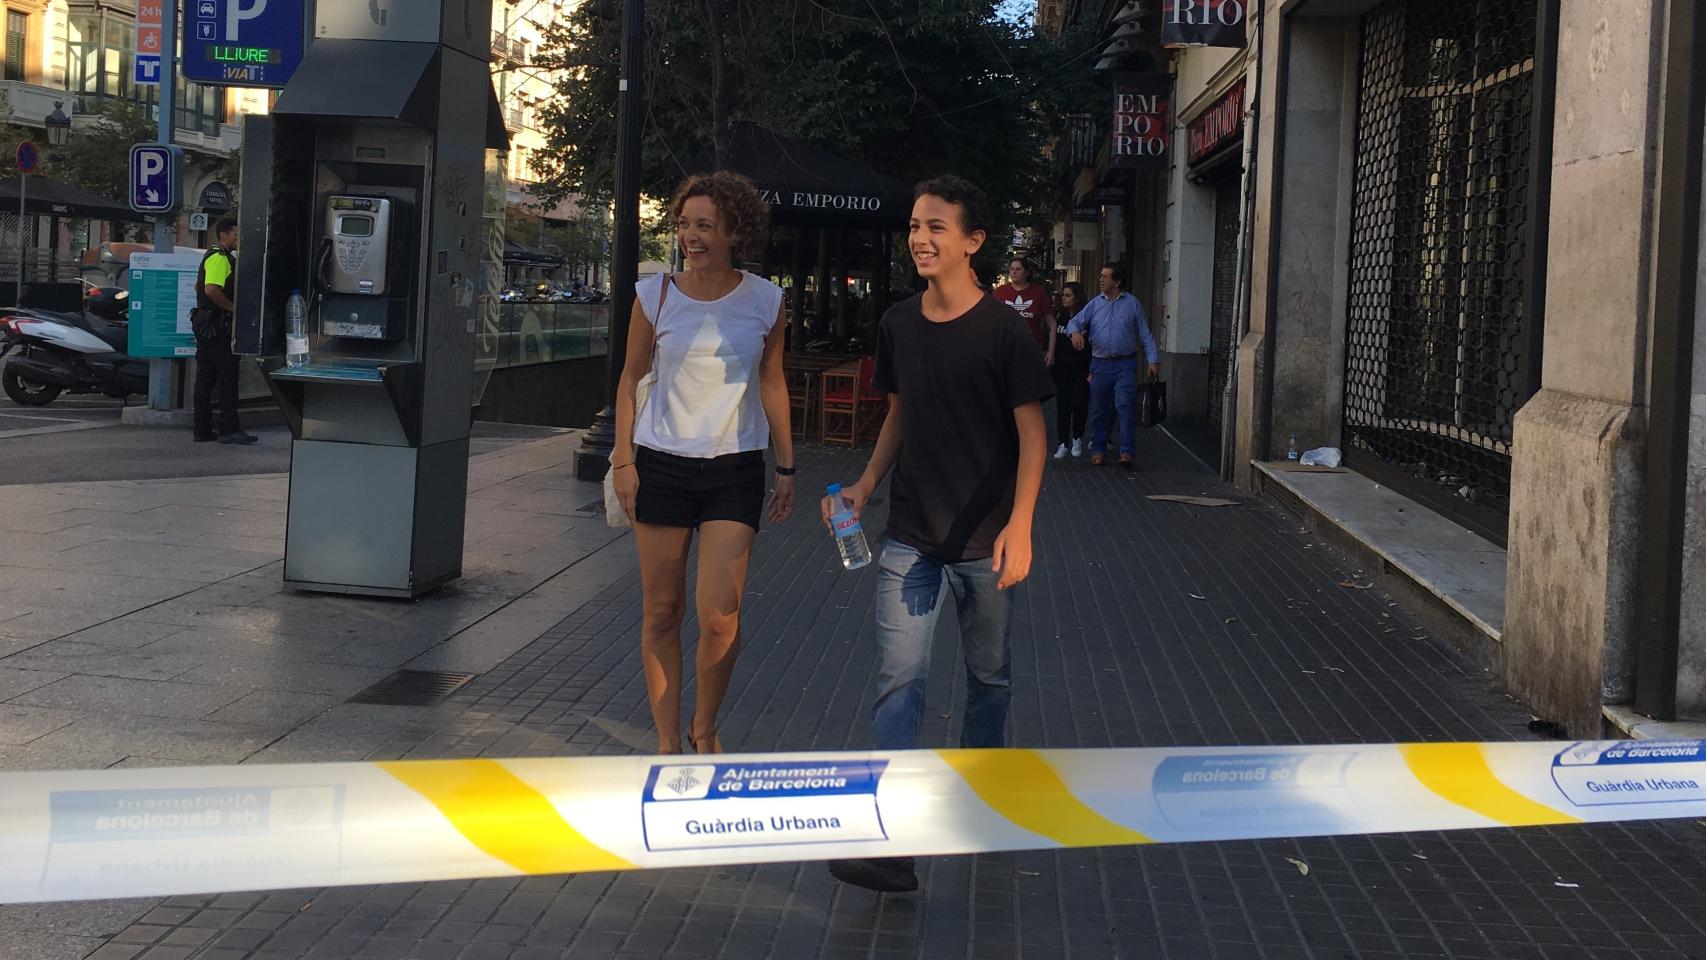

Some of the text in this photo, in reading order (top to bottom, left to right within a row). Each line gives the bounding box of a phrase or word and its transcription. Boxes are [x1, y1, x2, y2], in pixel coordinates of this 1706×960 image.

[225, 0, 267, 41] P
[1168, 0, 1243, 26] RIO
[214, 46, 269, 63] LLIURE
[1116, 94, 1161, 114] EM
[1112, 114, 1152, 135] PO
[1112, 135, 1165, 157] RIO
[140, 151, 164, 186] P
[793, 192, 881, 211] EMPORIO
[722, 766, 838, 782] Ajuntament
[718, 778, 847, 792] de Barcelona
[1586, 779, 1699, 793] Guàrdia Urbana
[685, 815, 841, 835] Guàrdia Urbana
